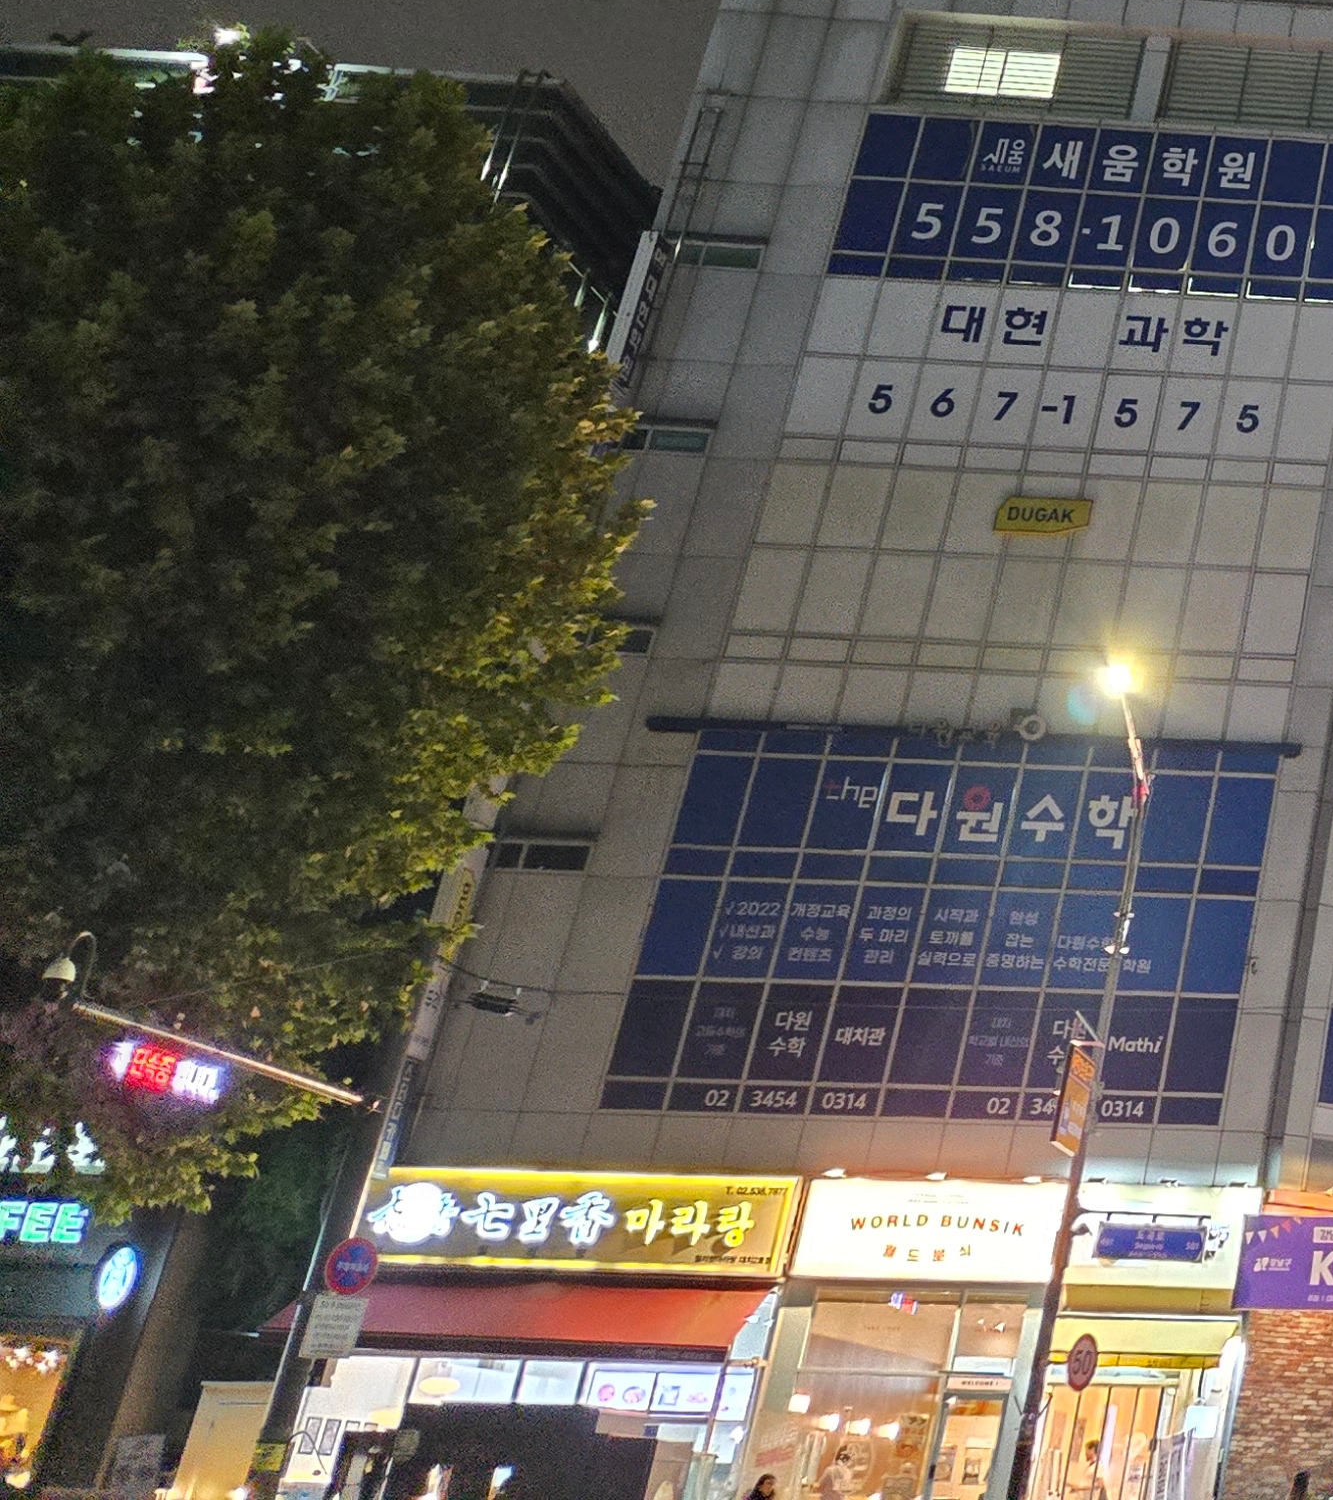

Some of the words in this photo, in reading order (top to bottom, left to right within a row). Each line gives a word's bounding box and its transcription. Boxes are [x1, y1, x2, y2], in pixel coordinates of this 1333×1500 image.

[1042, 140, 1256, 189] 새움학원
[940, 305, 1047, 347] 대현
[1118, 314, 1229, 356] 과학
[1006, 506, 1074, 525] DUGAK
[886, 785, 1139, 849] 다원수학
[737, 902, 781, 917] 2022
[790, 903, 851, 918] 개정교육
[867, 906, 912, 921] 과정의
[859, 928, 875, 941] 두
[878, 928, 909, 943] 마리
[863, 950, 895, 964] 관리
[917, 952, 977, 969] 실력으로
[1122, 959, 1151, 974] 학원
[774, 1010, 813, 1032] 다원
[767, 1036, 806, 1058] 수학
[835, 1026, 886, 1046] 대치관
[1108, 1035, 1164, 1054] Mathi
[704, 1090, 730, 1107] 02
[751, 1090, 797, 1108] 3454
[822, 1092, 868, 1110] 0314
[987, 1098, 1010, 1114] 02
[1101, 1100, 1144, 1118] 0314
[851, 1214, 928, 1231] WORLD
[940, 1215, 1025, 1237] BUNSIK
[1074, 1350, 1094, 1375] 50
